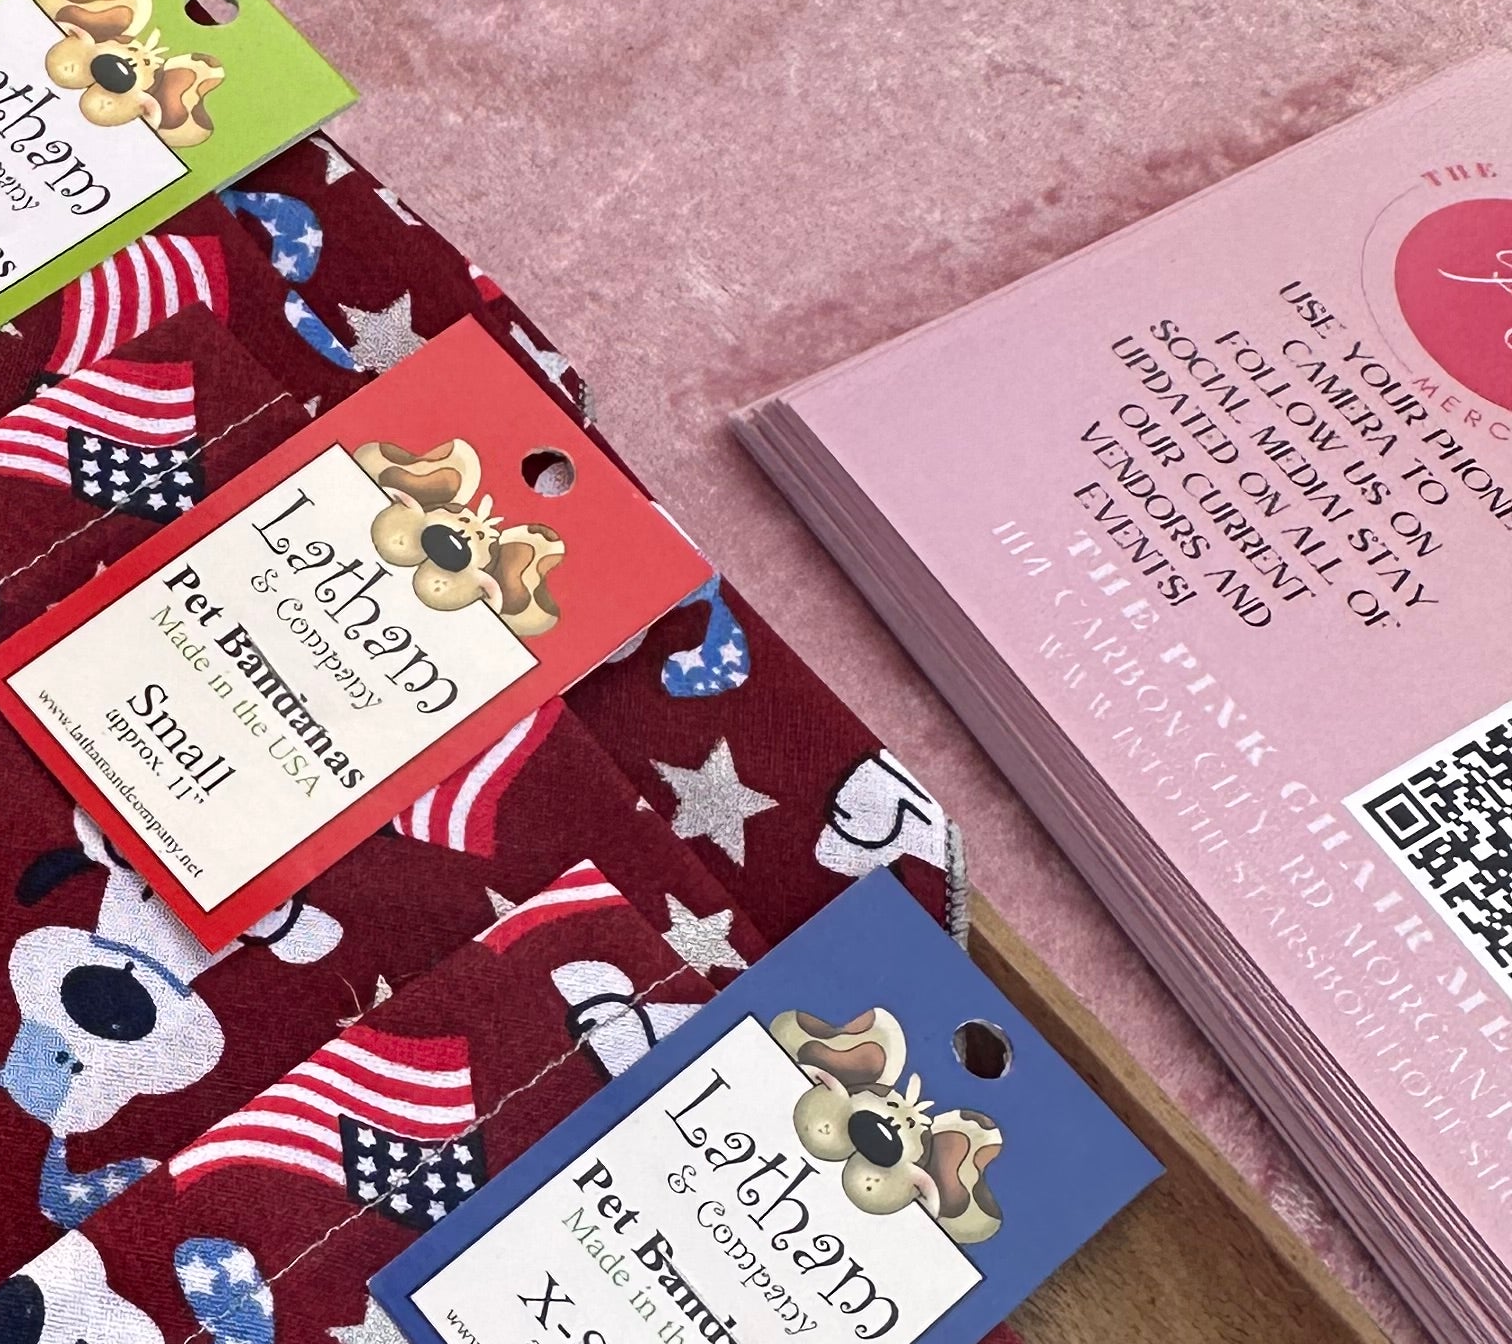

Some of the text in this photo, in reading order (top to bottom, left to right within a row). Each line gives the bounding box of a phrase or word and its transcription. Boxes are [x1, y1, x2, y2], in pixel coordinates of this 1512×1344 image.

[1420, 162, 1497, 187] THE
[1111, 336, 1401, 628] UPDATED ON ALL OF
[1118, 403, 1316, 601] OUR CURRENT
[1149, 319, 1250, 424] SOCIAL
[1348, 528, 1439, 608] STAY
[1214, 330, 1443, 558] FOLLOW US ON
[1279, 280, 1512, 531] USE YOUR PHONE
[1283, 339, 1450, 506] CAMERA TO
[1411, 376, 1511, 441] MERC
[252, 488, 460, 716] Latham
[1073, 481, 1197, 606] EVENTS!
[1080, 421, 1272, 628] VENDORS AND
[149, 604, 319, 799] Made in the USA
[163, 564, 366, 793] Pet Bandanas
[251, 567, 384, 711] & Company
[39, 690, 204, 878] www.lathamandcompany.net
[106, 708, 164, 777] approx.
[126, 683, 236, 796] Small
[1067, 529, 1159, 630] THE
[1160, 642, 1279, 768] PINK
[1279, 780, 1434, 954] CHAIR
[1054, 589, 1191, 736] CARBON
[1194, 752, 1268, 835] CITY
[1280, 854, 1334, 907] RD
[1334, 922, 1512, 1142] MORGANT
[560, 1205, 632, 1287] Made
[627, 1280, 660, 1325] in
[571, 1157, 640, 1236] Pet
[664, 1068, 902, 1343] Latham
[667, 1164, 819, 1337] & Company
